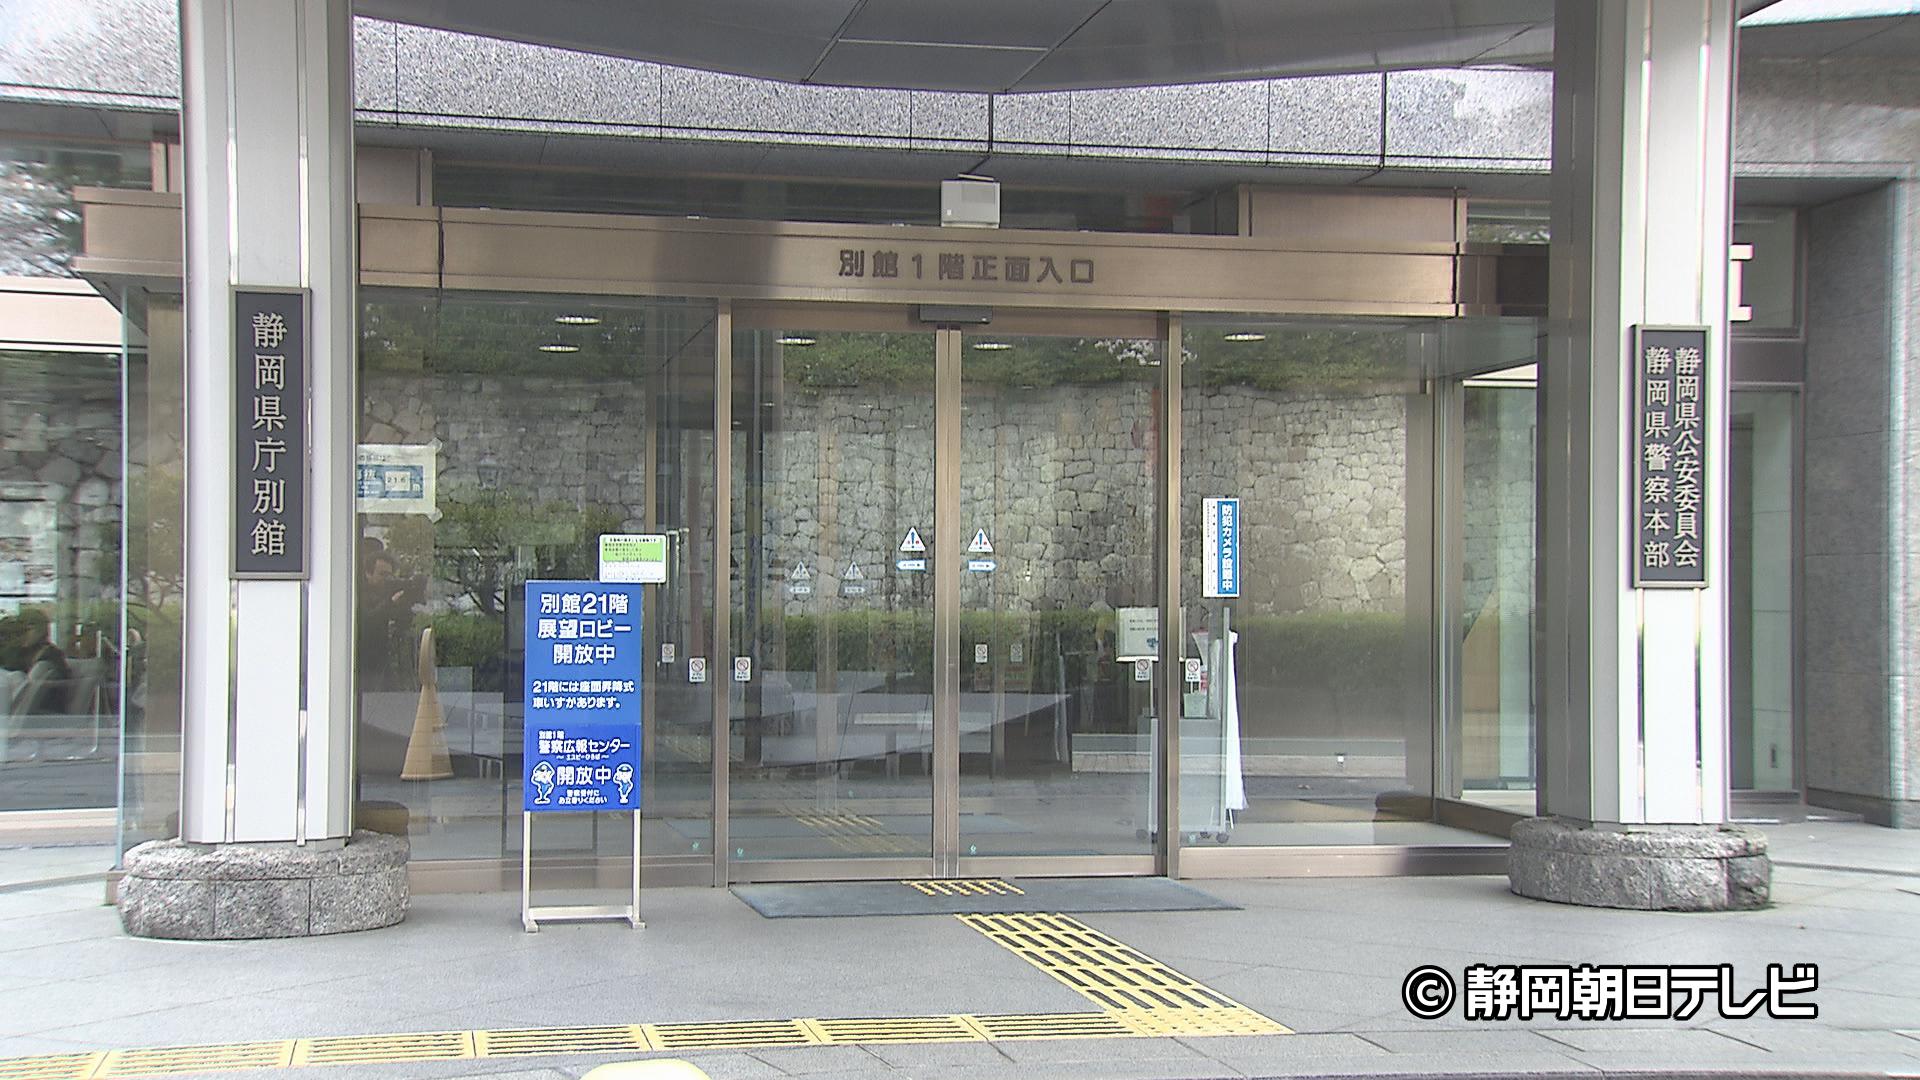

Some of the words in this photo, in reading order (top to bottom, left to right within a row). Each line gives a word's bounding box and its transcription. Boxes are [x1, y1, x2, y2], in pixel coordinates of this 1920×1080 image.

[838, 249, 1095, 284] 別館1階正面入口
[251, 312, 287, 556] 静岡県庁別館
[1643, 346, 1673, 569] 静岡県警察本部
[1673, 346, 1702, 568] 静岡県公安委員会
[540, 592, 629, 614] 別館21階
[537, 618, 632, 639] 展望ロビー
[553, 643, 616, 665] 開放中
[538, 738, 631, 754] 警察広報センター
[556, 765, 612, 786] 開放中
